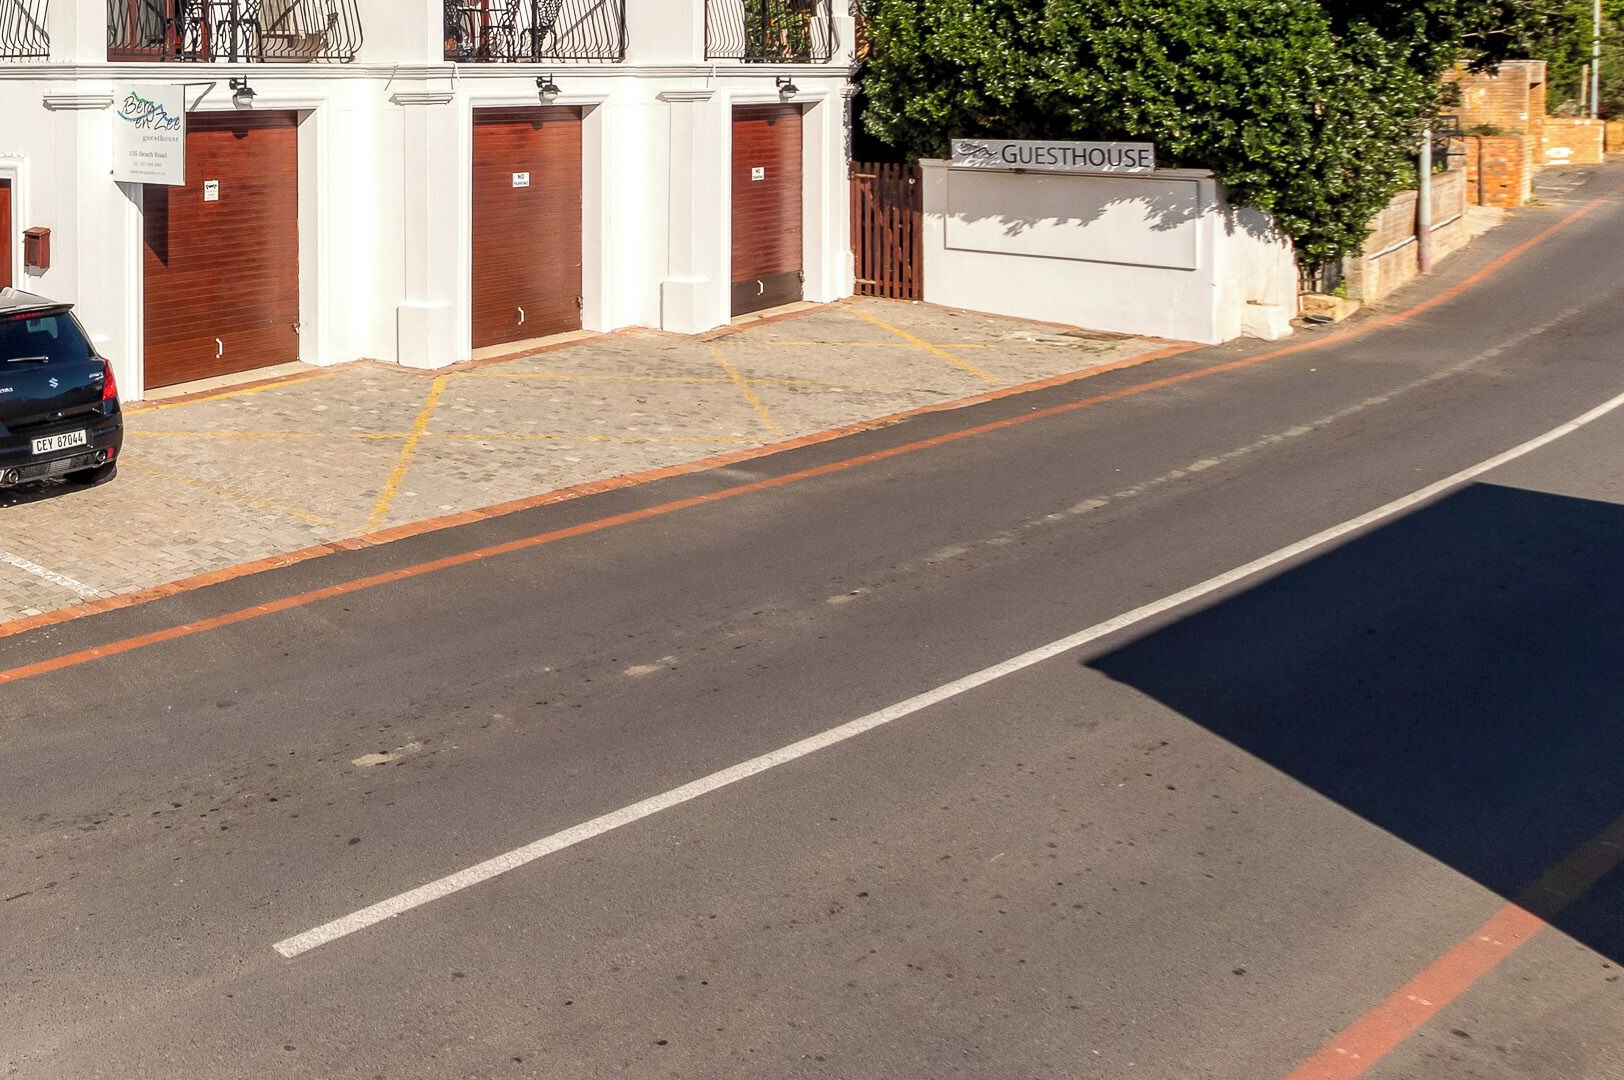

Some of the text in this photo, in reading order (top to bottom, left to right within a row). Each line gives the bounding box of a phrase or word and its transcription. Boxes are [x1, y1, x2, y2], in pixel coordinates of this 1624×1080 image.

[124, 95, 155, 122] Berg
[135, 111, 181, 131] en Zee
[143, 135, 179, 143] guesthouse
[1001, 144, 1150, 168] GUESTHOUSE
[36, 432, 83, 451] CEY 87044
